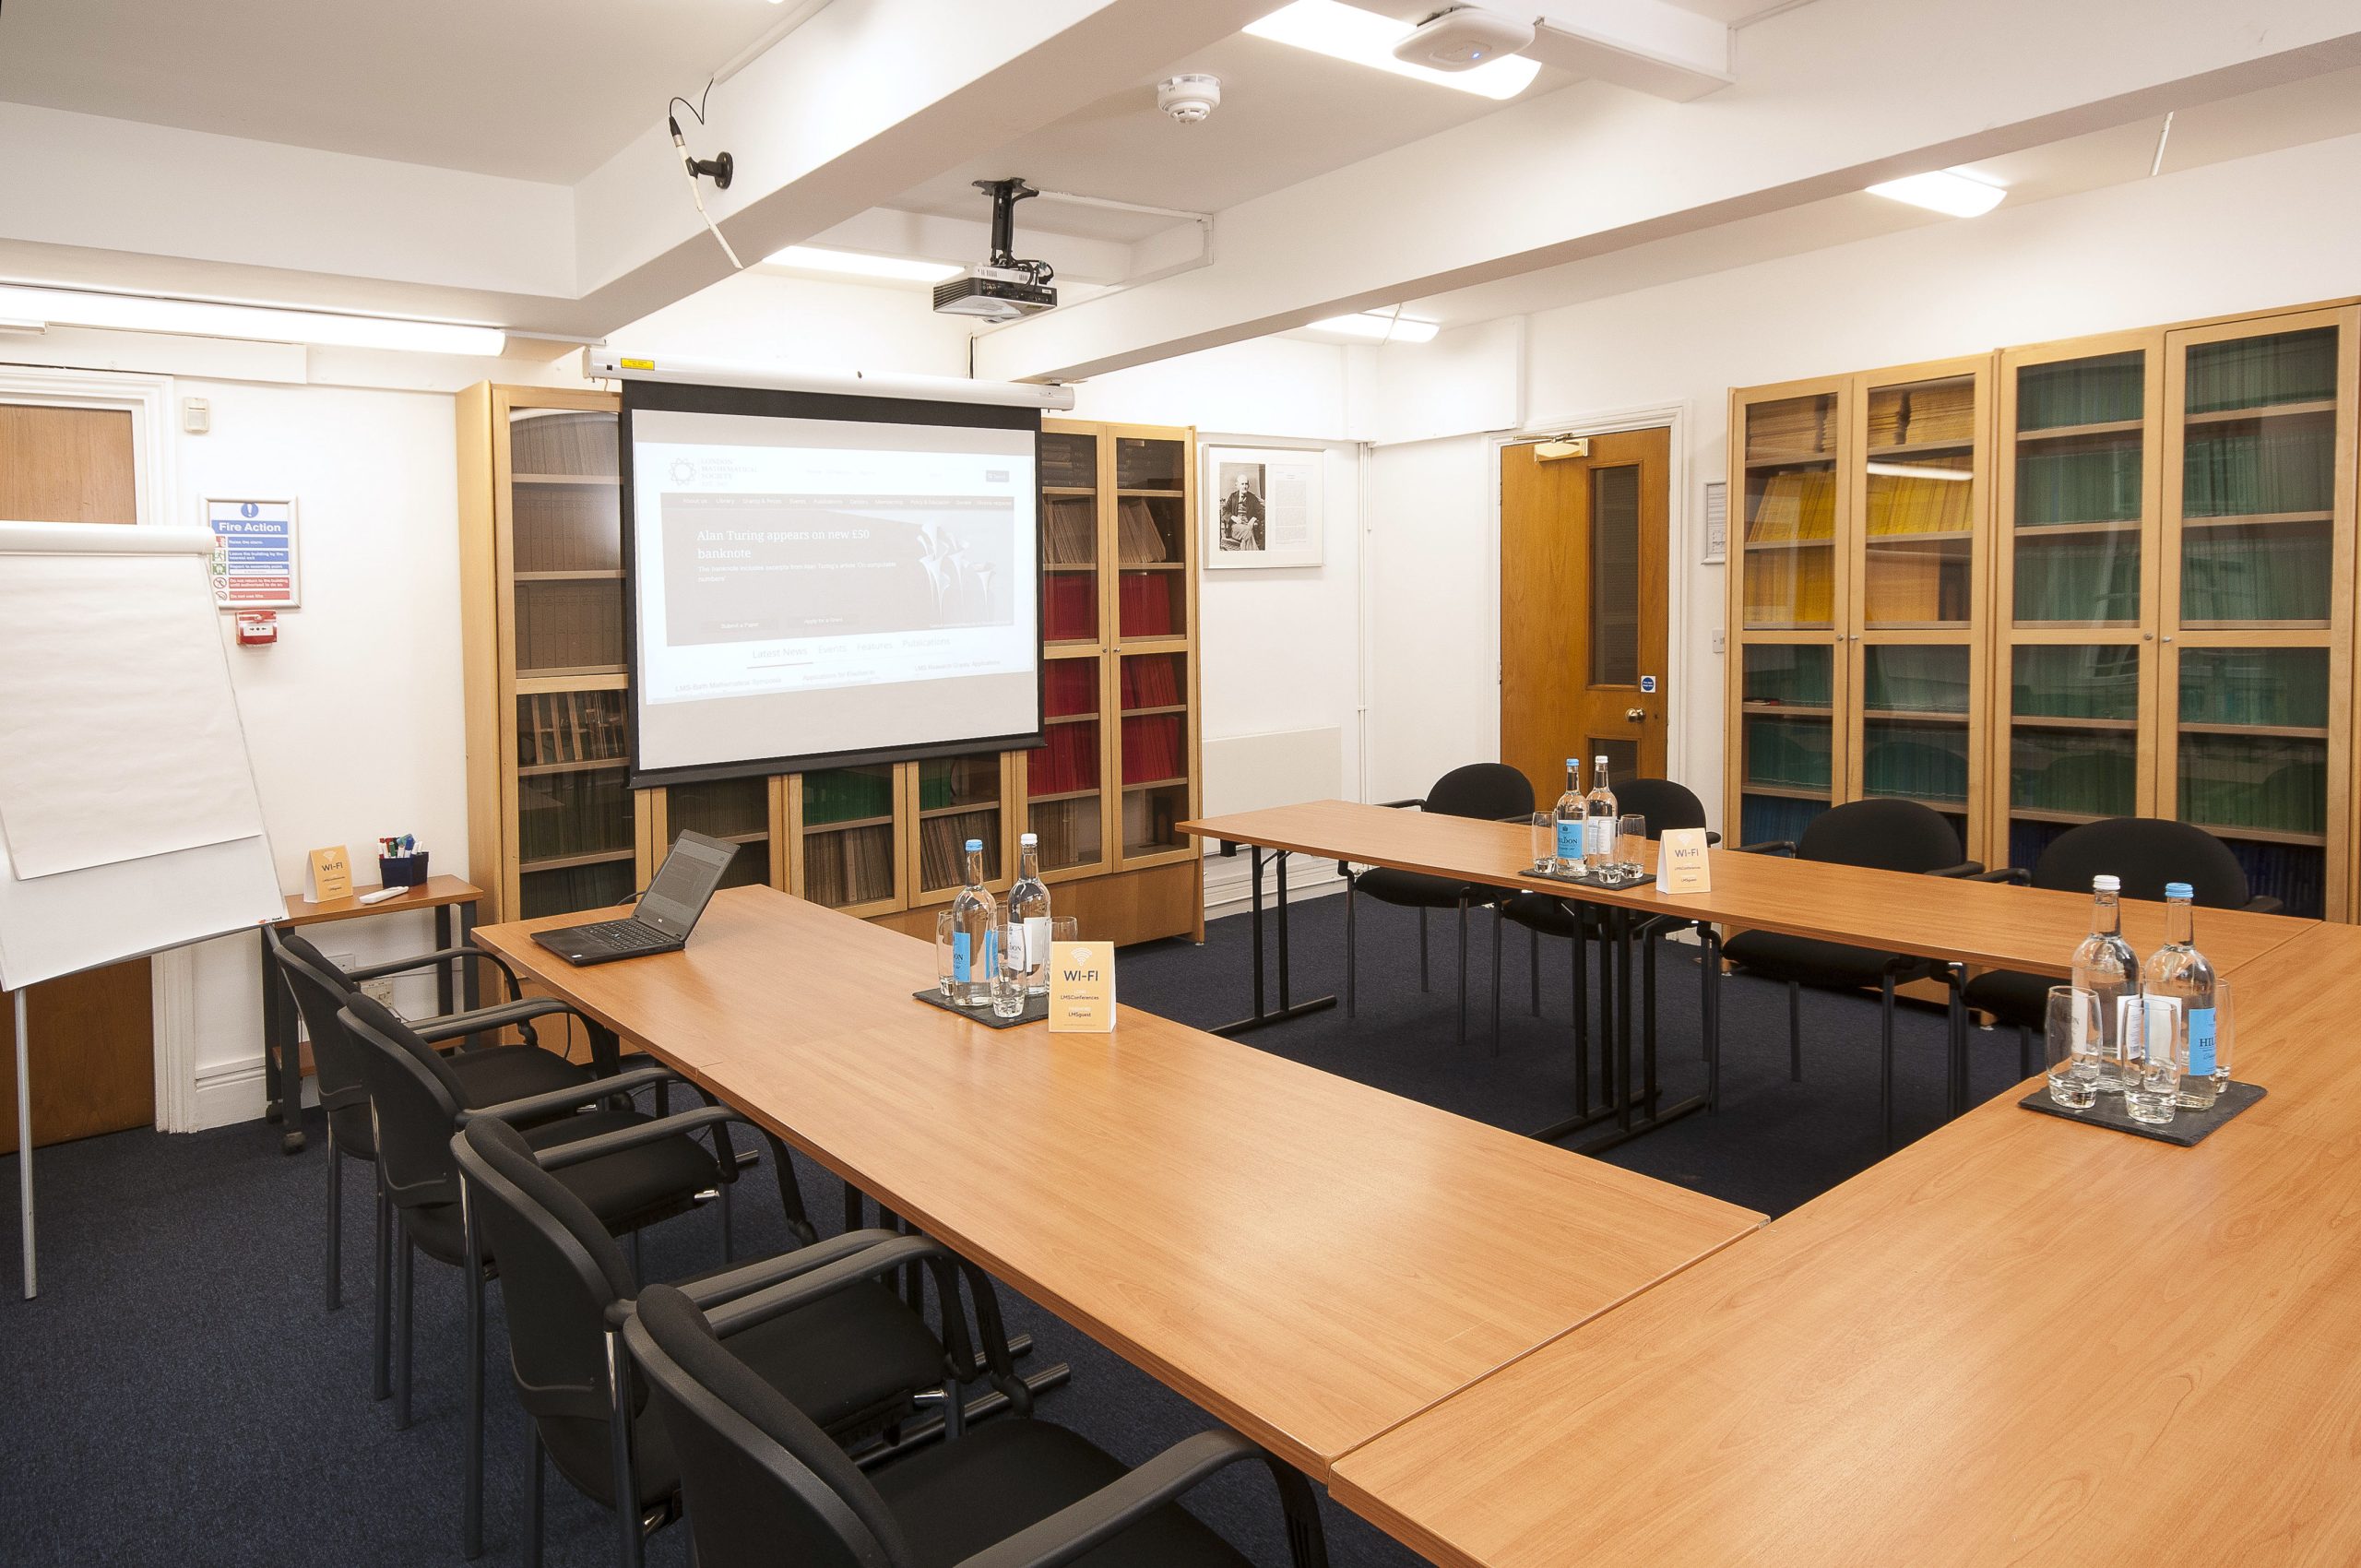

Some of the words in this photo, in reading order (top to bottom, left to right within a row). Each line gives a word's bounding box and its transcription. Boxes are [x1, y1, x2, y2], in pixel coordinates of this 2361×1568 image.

[219, 522, 243, 532] Fire
[244, 522, 281, 532] Action
[696, 530, 724, 541] Alan
[726, 530, 765, 543] Turing
[766, 530, 810, 542] appears
[812, 532, 825, 540] on
[827, 531, 849, 540] new
[851, 529, 870, 540] £50
[698, 548, 752, 559] banknote
[857, 641, 894, 652] Features
[902, 636, 951, 649] Publications
[753, 648, 780, 659] Latest
[783, 647, 808, 657] News
[818, 644, 848, 654] Events
[1674, 848, 1699, 858] WI-FI
[321, 861, 344, 872] WI-FI
[1063, 969, 1098, 982] WI-FI
